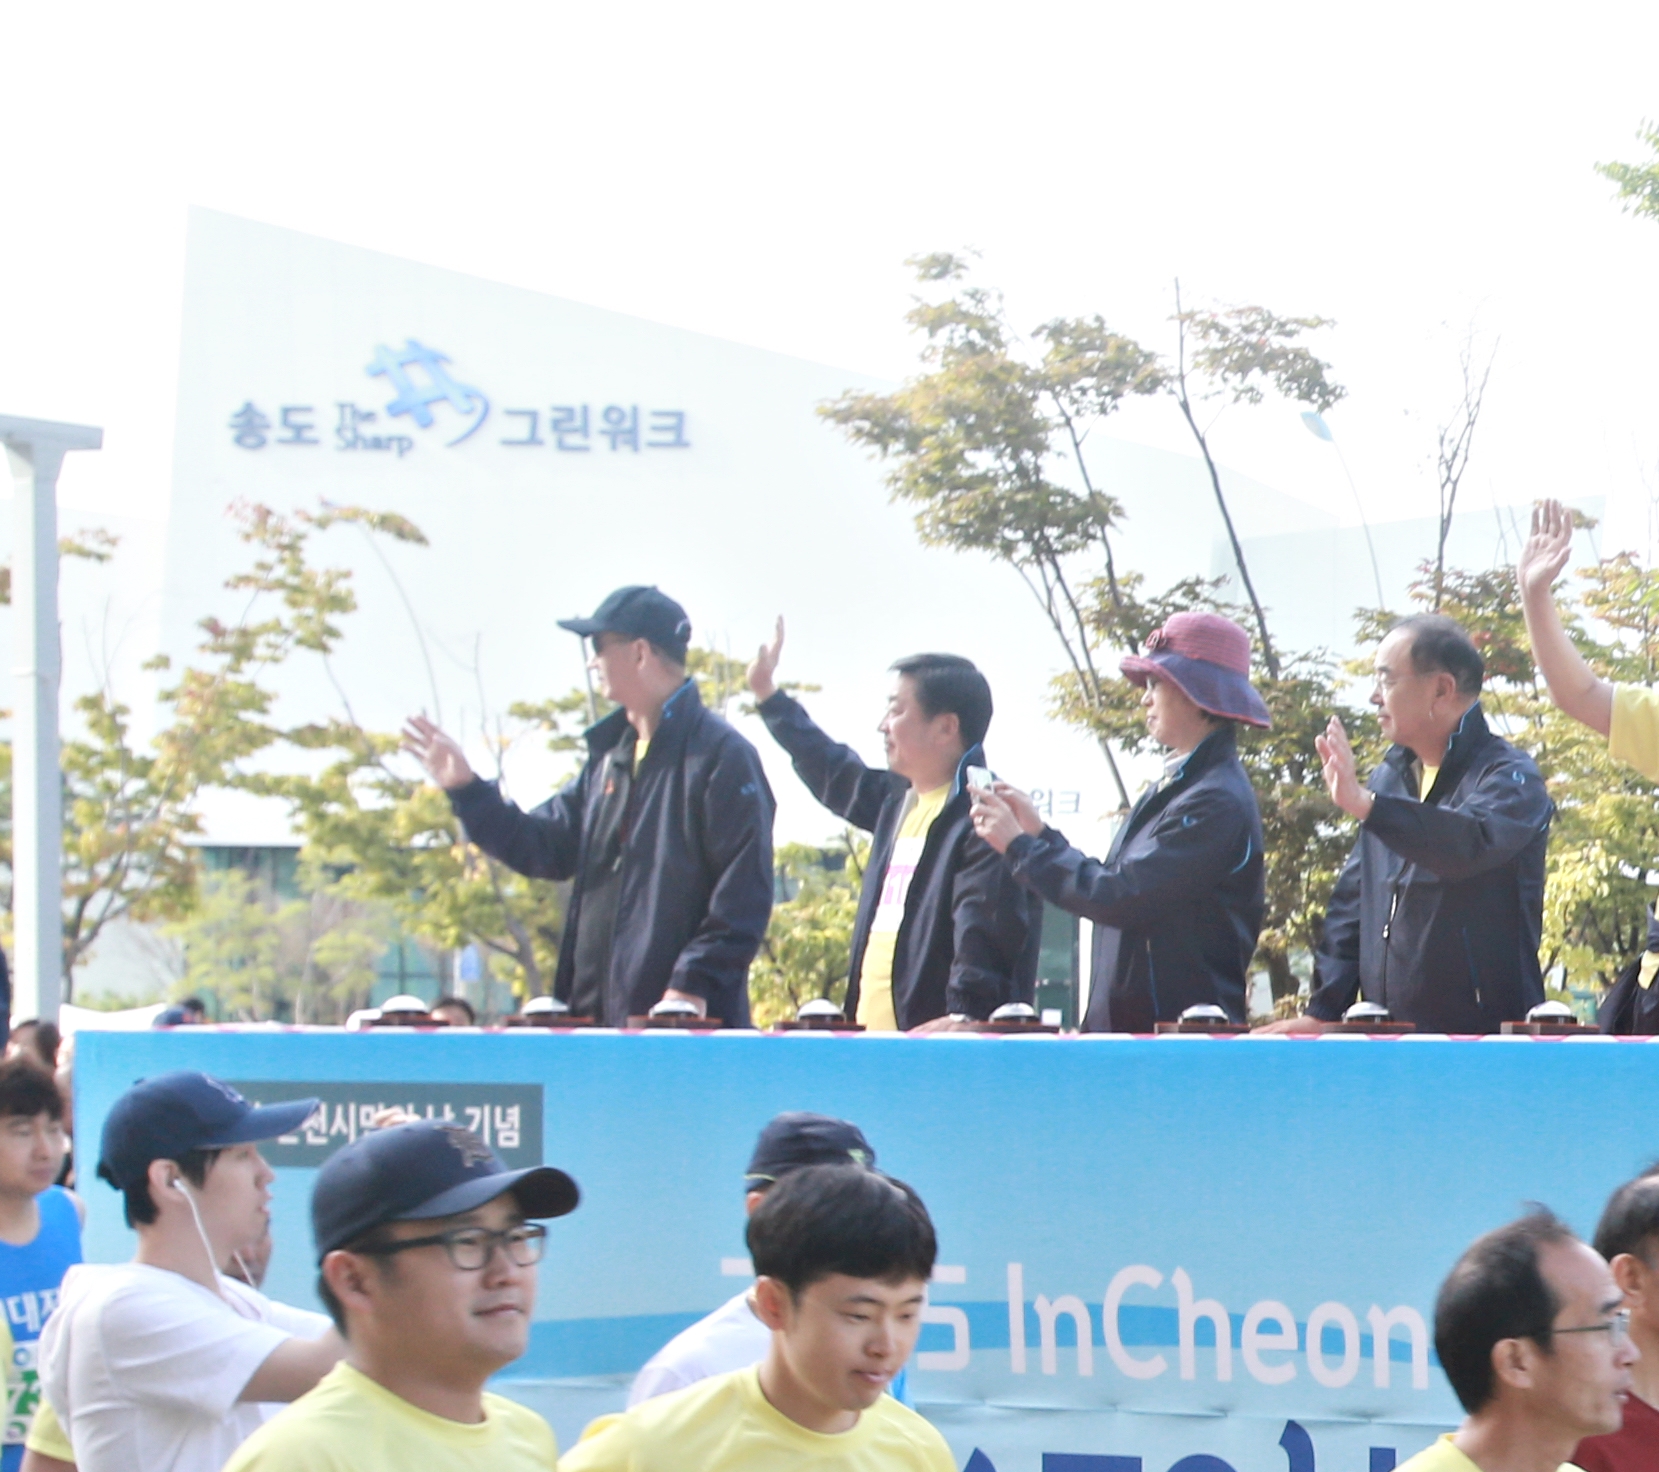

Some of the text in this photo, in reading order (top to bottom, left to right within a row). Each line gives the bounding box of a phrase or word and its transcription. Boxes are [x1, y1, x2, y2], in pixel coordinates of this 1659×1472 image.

[230, 402, 320, 451] 송도
[335, 429, 415, 458] Sharp
[501, 403, 692, 454] 그린워크
[1007, 1262, 1429, 1391] InCheon
